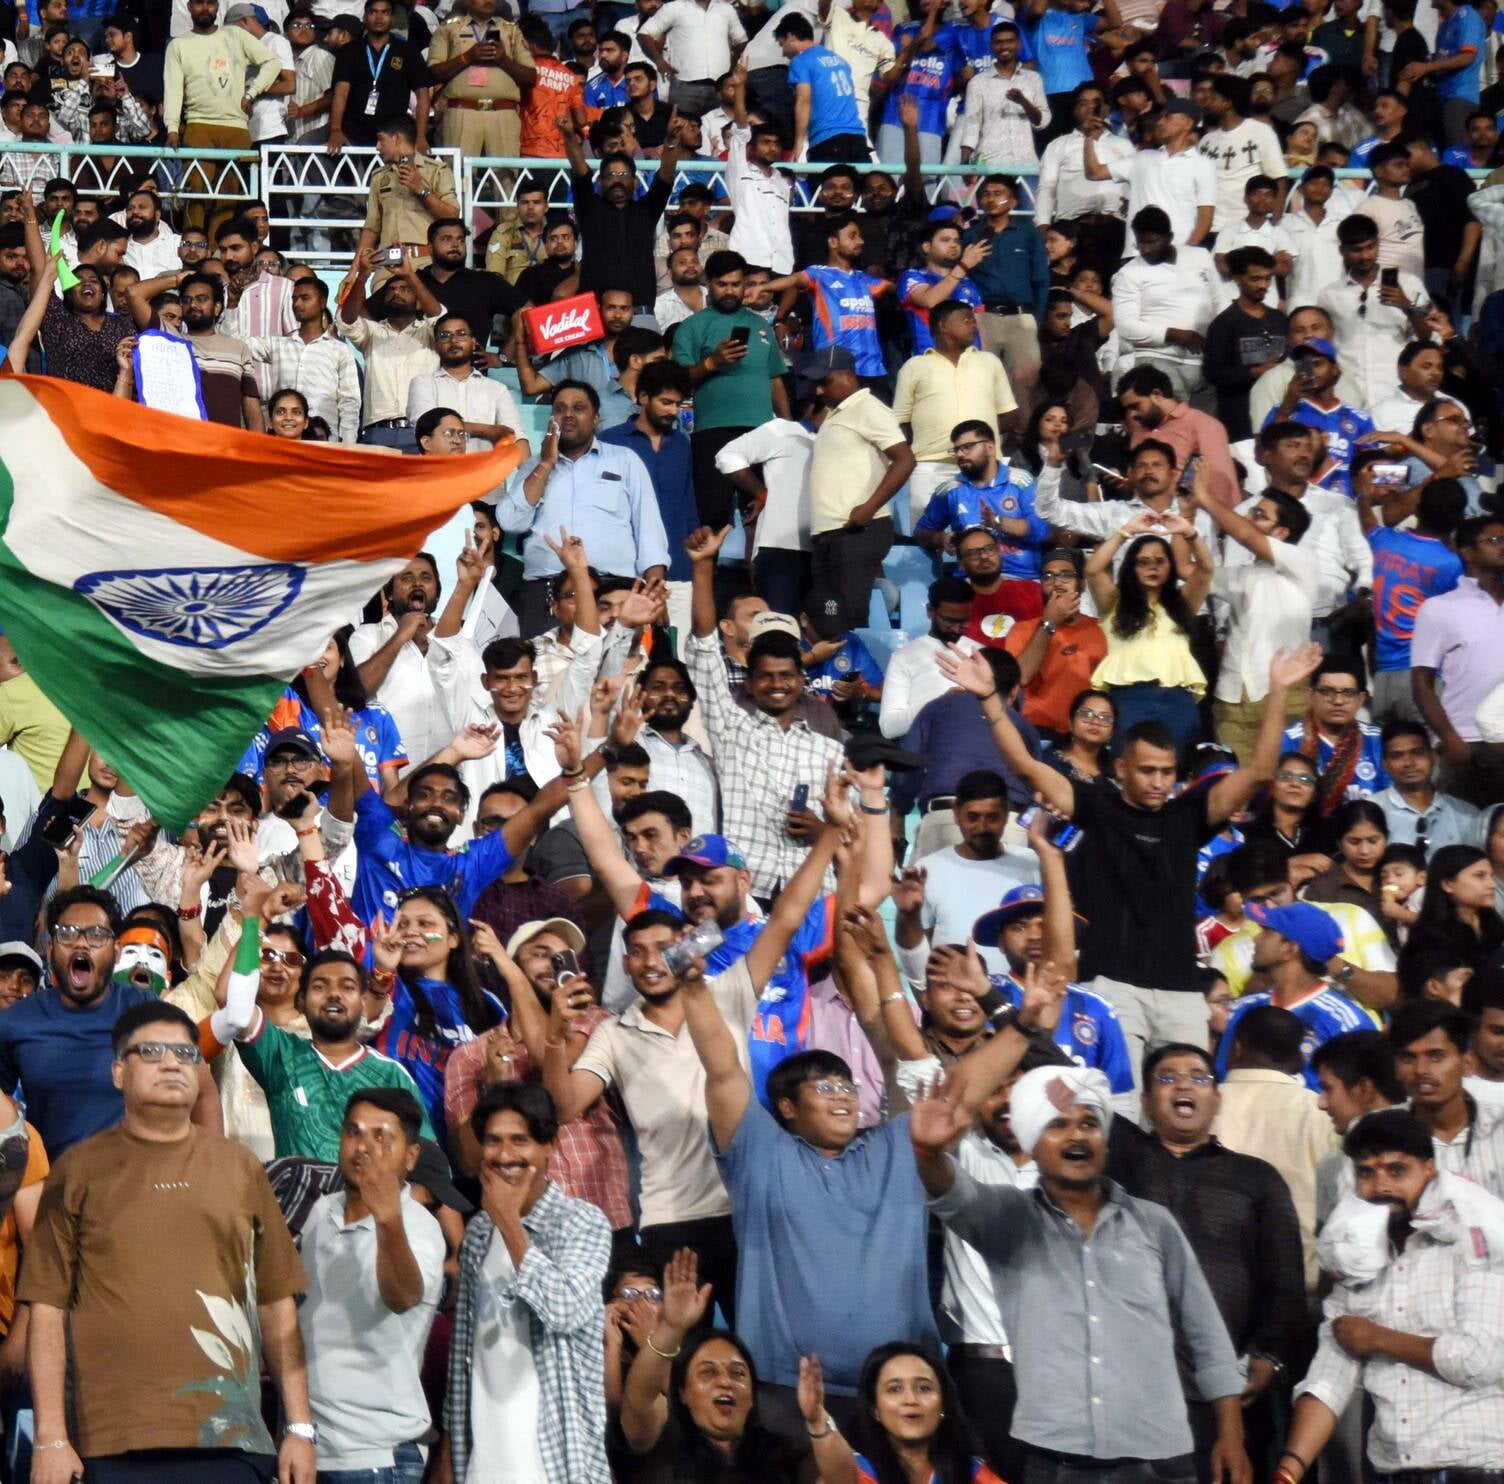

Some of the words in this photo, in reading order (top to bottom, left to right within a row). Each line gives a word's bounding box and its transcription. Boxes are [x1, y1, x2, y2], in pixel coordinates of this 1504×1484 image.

[910, 56, 945, 70] pollo
[538, 76, 571, 94] ARMY
[831, 69, 853, 97] 18
[906, 70, 941, 90] NDIA
[539, 308, 593, 341] Vadilal
[1371, 573, 1427, 640] 18
